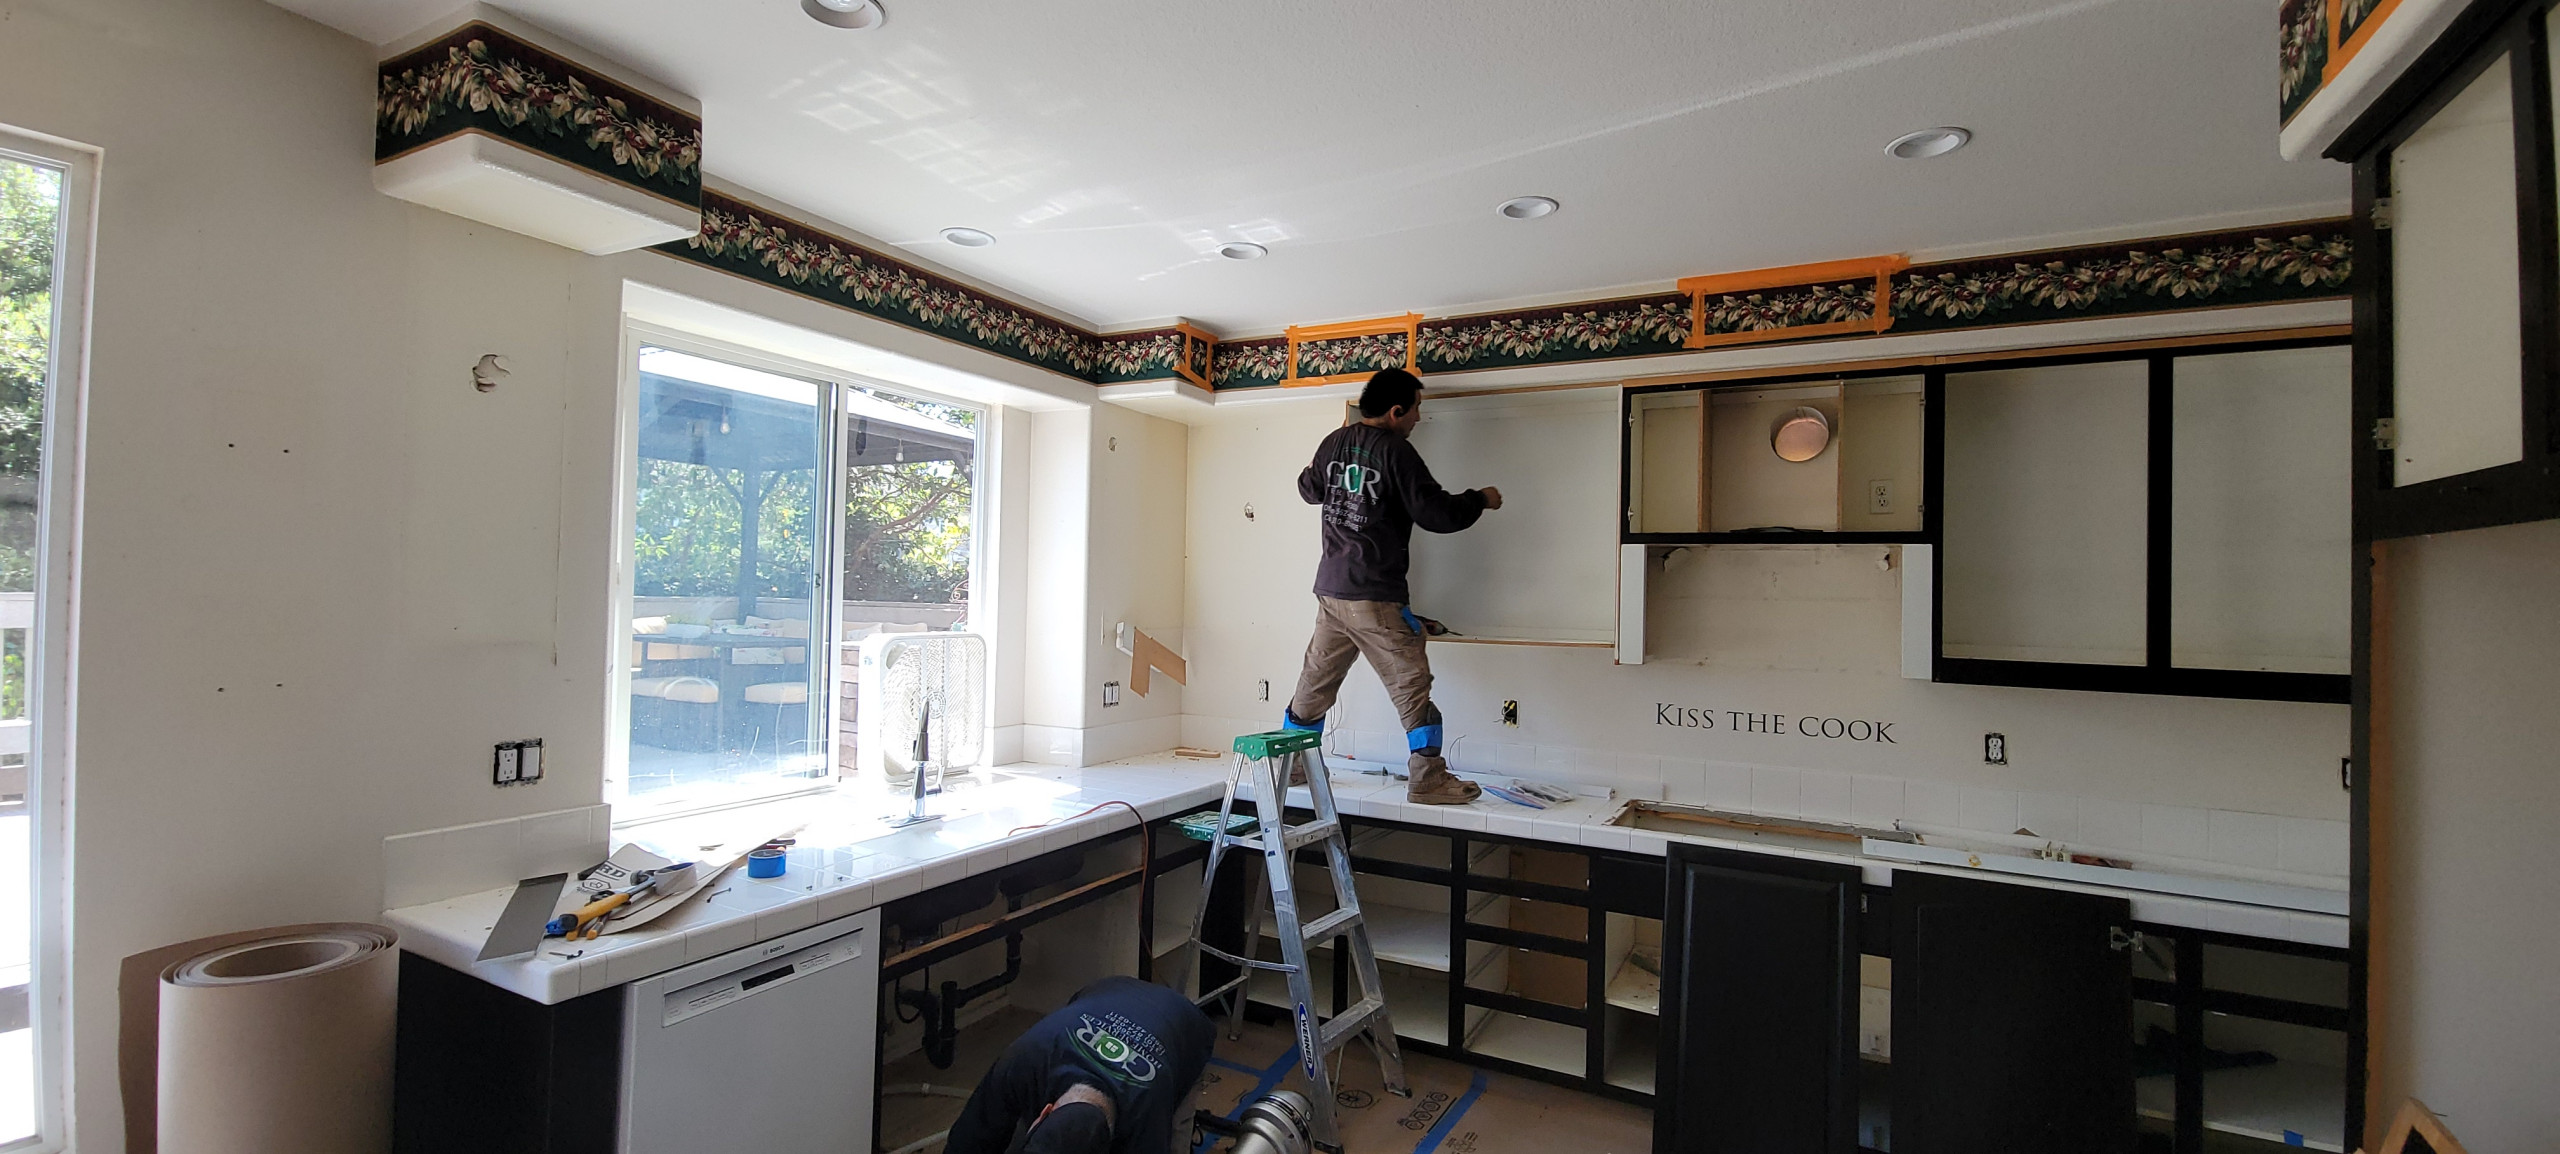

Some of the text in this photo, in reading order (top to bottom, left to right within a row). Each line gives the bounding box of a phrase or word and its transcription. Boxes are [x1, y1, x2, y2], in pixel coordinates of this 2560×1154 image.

[1326, 461, 1380, 499] GCR
[1655, 702, 1897, 744] KISS THE COOK
[1076, 1016, 1156, 1081] GCR
[1082, 1013, 1162, 1069] HOME SERVICES
[1301, 1020, 1313, 1064] WERNER
